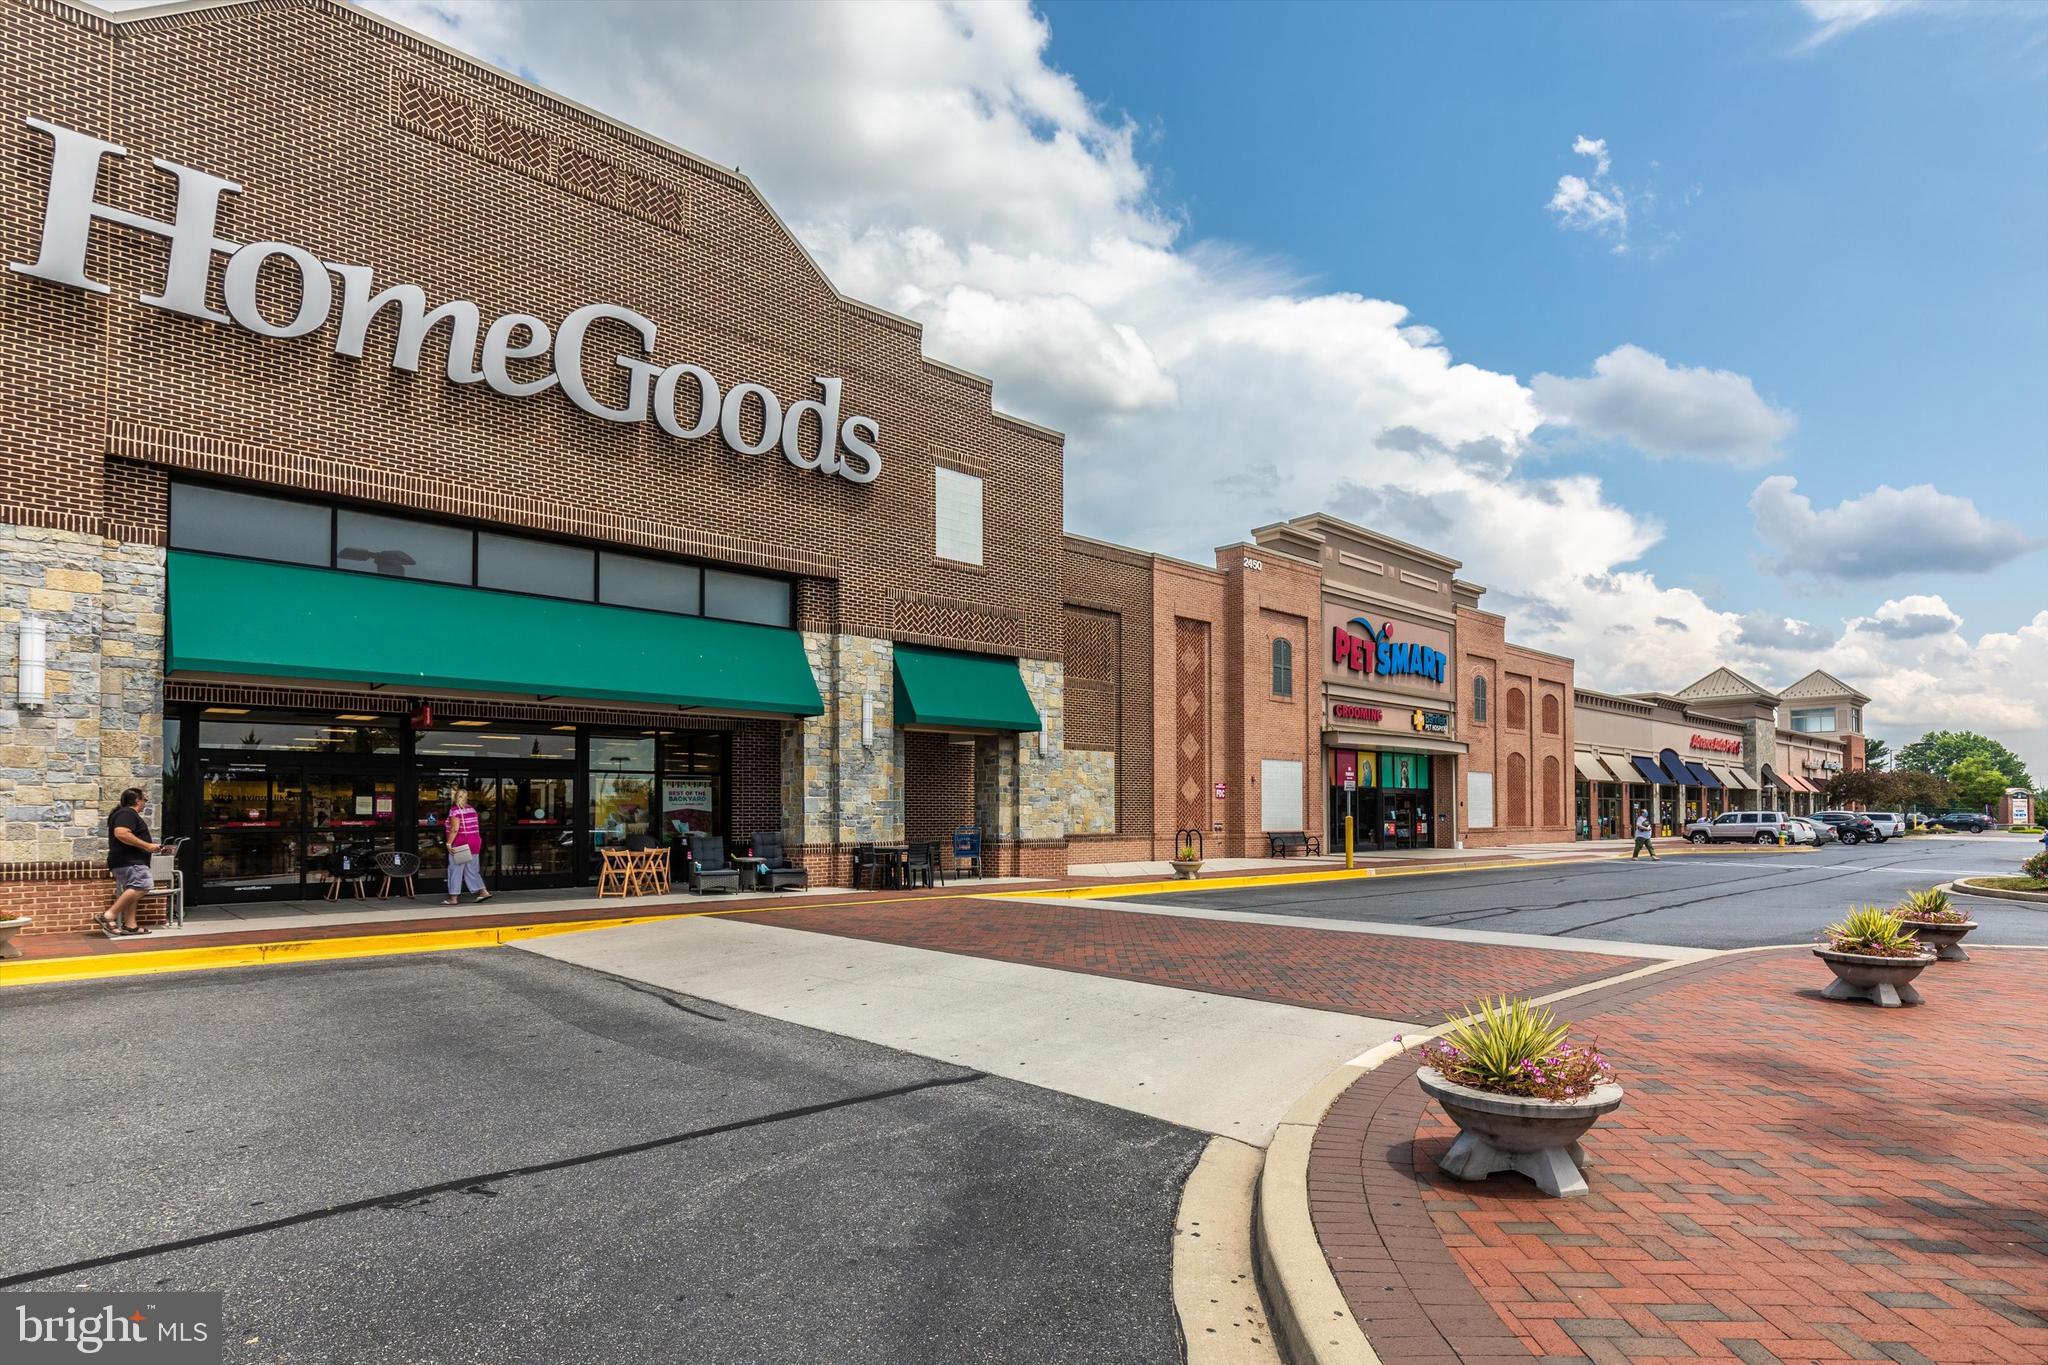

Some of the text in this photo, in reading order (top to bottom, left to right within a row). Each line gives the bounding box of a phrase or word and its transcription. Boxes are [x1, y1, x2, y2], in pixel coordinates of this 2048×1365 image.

[10, 116, 884, 485] HomeGoods
[1243, 557, 1263, 571] 2450
[1334, 703, 1383, 722] GROOMING
[1216, 789, 1226, 798] FDC
